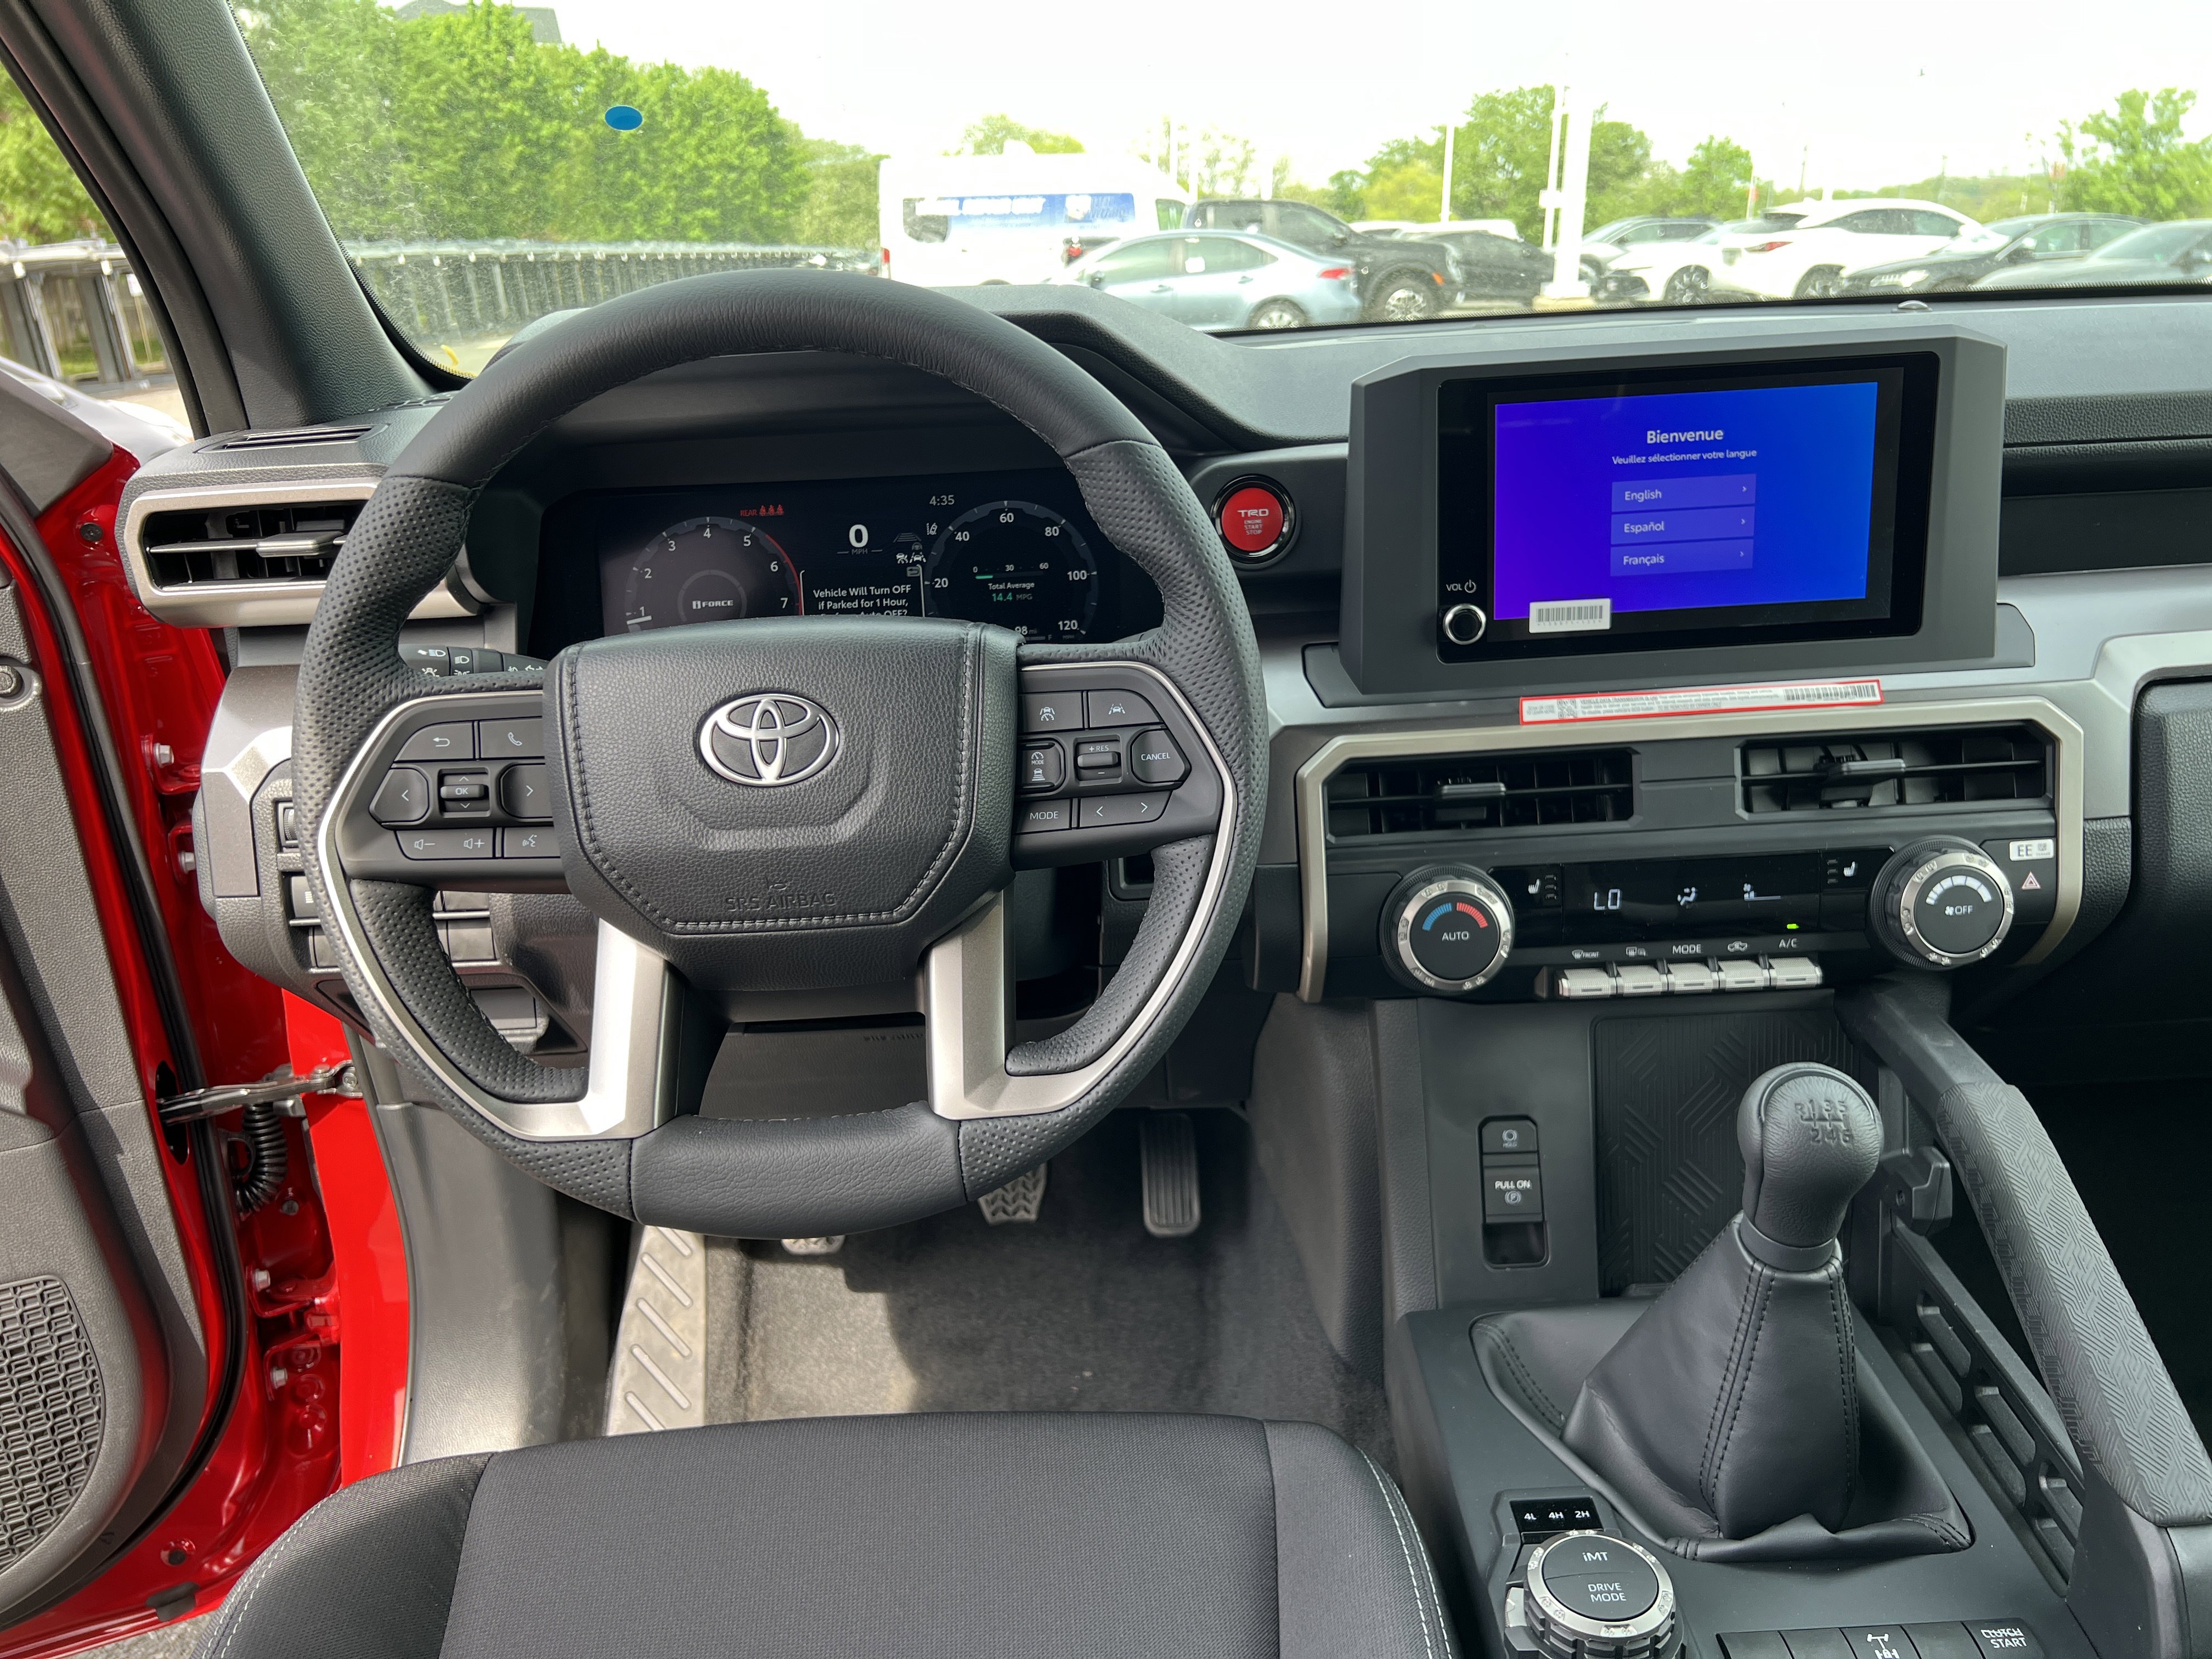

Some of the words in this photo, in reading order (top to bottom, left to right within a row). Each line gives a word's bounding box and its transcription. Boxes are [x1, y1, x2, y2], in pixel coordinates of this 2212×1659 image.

[1647, 430, 1724, 443] Bienvenue
[1612, 455, 1646, 465] Veuillez
[1648, 453, 1701, 462] sélectionner
[1726, 449, 1757, 460] langue
[929, 495, 955, 505] 4:35
[1624, 489, 1662, 503] English
[1000, 513, 1014, 522] 60
[1237, 509, 1269, 517] TRD
[1045, 527, 1059, 536] 80
[1624, 521, 1664, 534] Español
[703, 528, 712, 538] 4
[849, 524, 868, 548] 0
[955, 531, 970, 541] 40
[668, 540, 676, 551] 3
[743, 535, 752, 546] 5
[1623, 554, 1664, 566] Français
[770, 561, 778, 572] 6
[644, 568, 652, 578] 2
[1067, 571, 1087, 580] 100
[934, 578, 949, 588] 20
[813, 588, 847, 598] Vehicle
[849, 586, 868, 596] Will
[869, 586, 890, 595] Turn
[892, 585, 911, 594] OFF
[992, 592, 1012, 602] 14.4
[781, 597, 788, 608] 7
[818, 601, 825, 610] if
[827, 600, 858, 610] Parked
[860, 599, 874, 608] for
[876, 599, 880, 607] 1
[883, 598, 909, 607] Hour,
[639, 606, 645, 616] 1
[1058, 620, 1078, 630] 120
[1141, 753, 1170, 761] CANCEL
[455, 787, 469, 795] OK
[1030, 811, 1059, 820] MODE
[725, 897, 760, 912] SRS
[769, 894, 836, 910] AIRBAG
[1594, 888, 1621, 911] LO
[1955, 905, 1973, 915] OFF
[1442, 931, 1469, 941] AUTO
[1779, 938, 1797, 949] A/C
[1672, 944, 1703, 955] MODE
[1495, 1181, 1515, 1189] PULL
[1516, 1180, 1531, 1189] ON
[1549, 1511, 1564, 1520] 4H
[1575, 1510, 1590, 1519] 2H
[1583, 1551, 1607, 1561] iMT
[1588, 1583, 1622, 1592] DRIVE
[1590, 1593, 1627, 1602] MODE
[1980, 1628, 2024, 1638] CLUTCH
[1990, 1637, 2027, 1649] START
